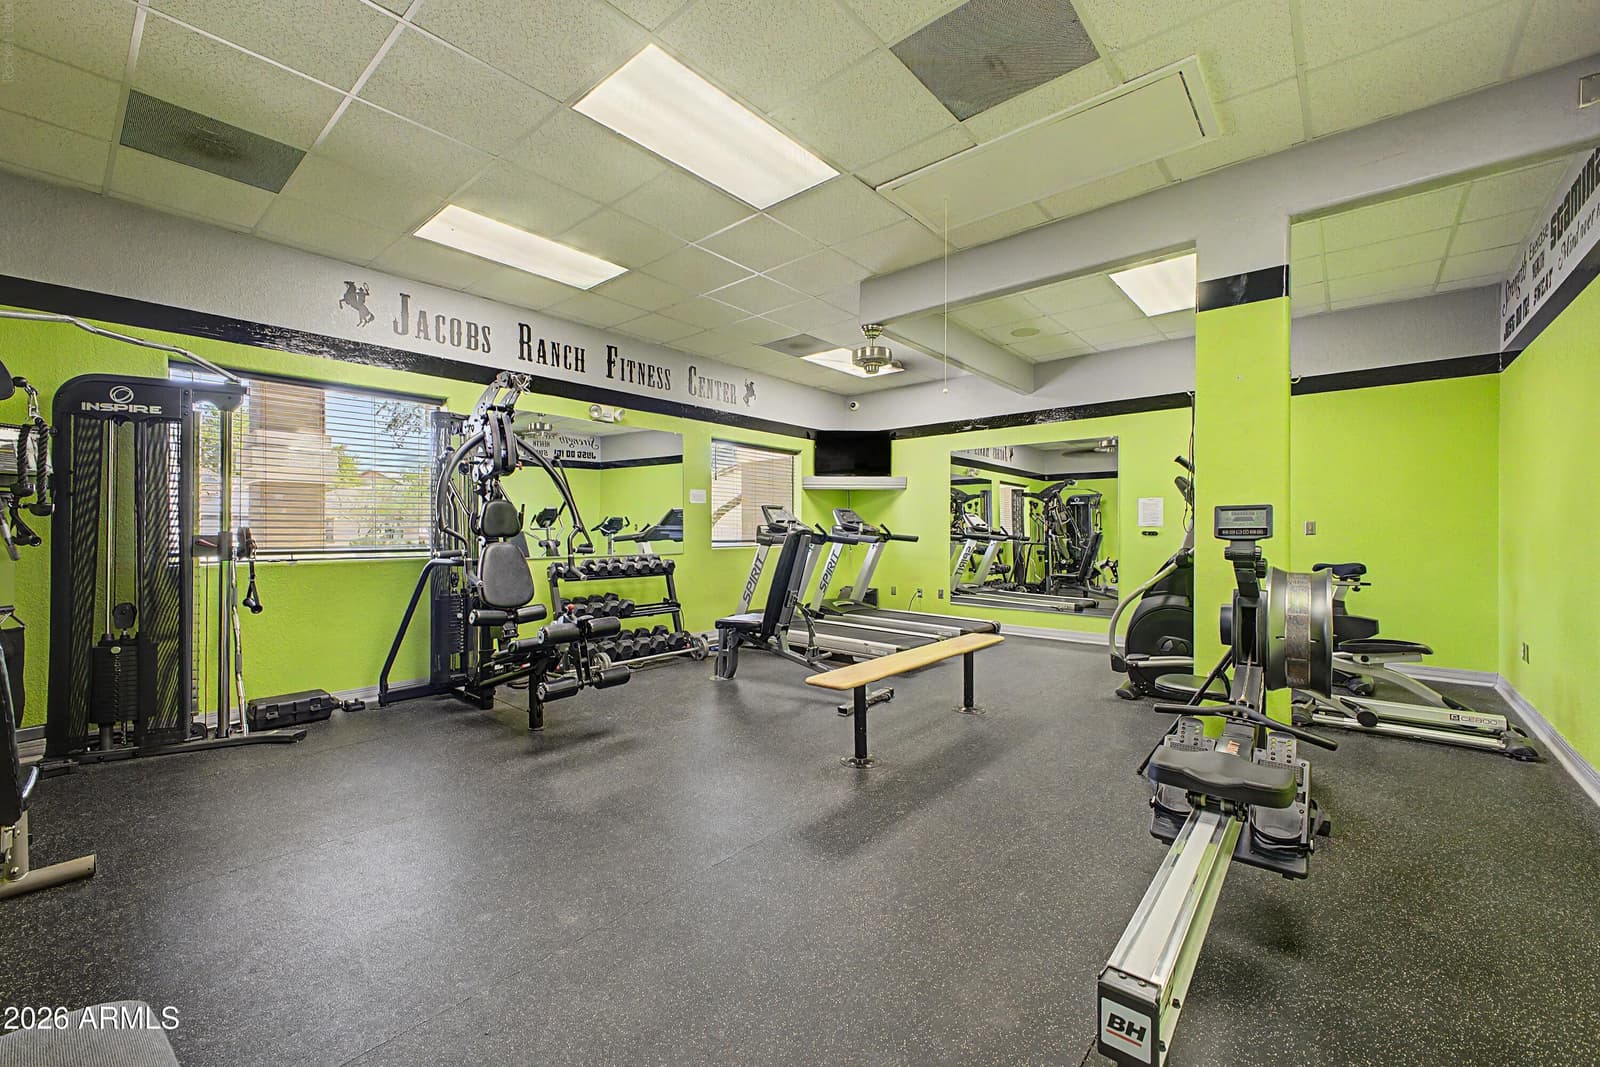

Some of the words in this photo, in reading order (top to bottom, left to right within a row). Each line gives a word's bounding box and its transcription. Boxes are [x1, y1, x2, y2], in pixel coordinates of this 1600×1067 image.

[81, 402, 162, 414] INSPIRE
[743, 553, 764, 604] SPIRIT
[819, 550, 839, 592] SPIRIT
[1106, 1012, 1147, 1043] BH
